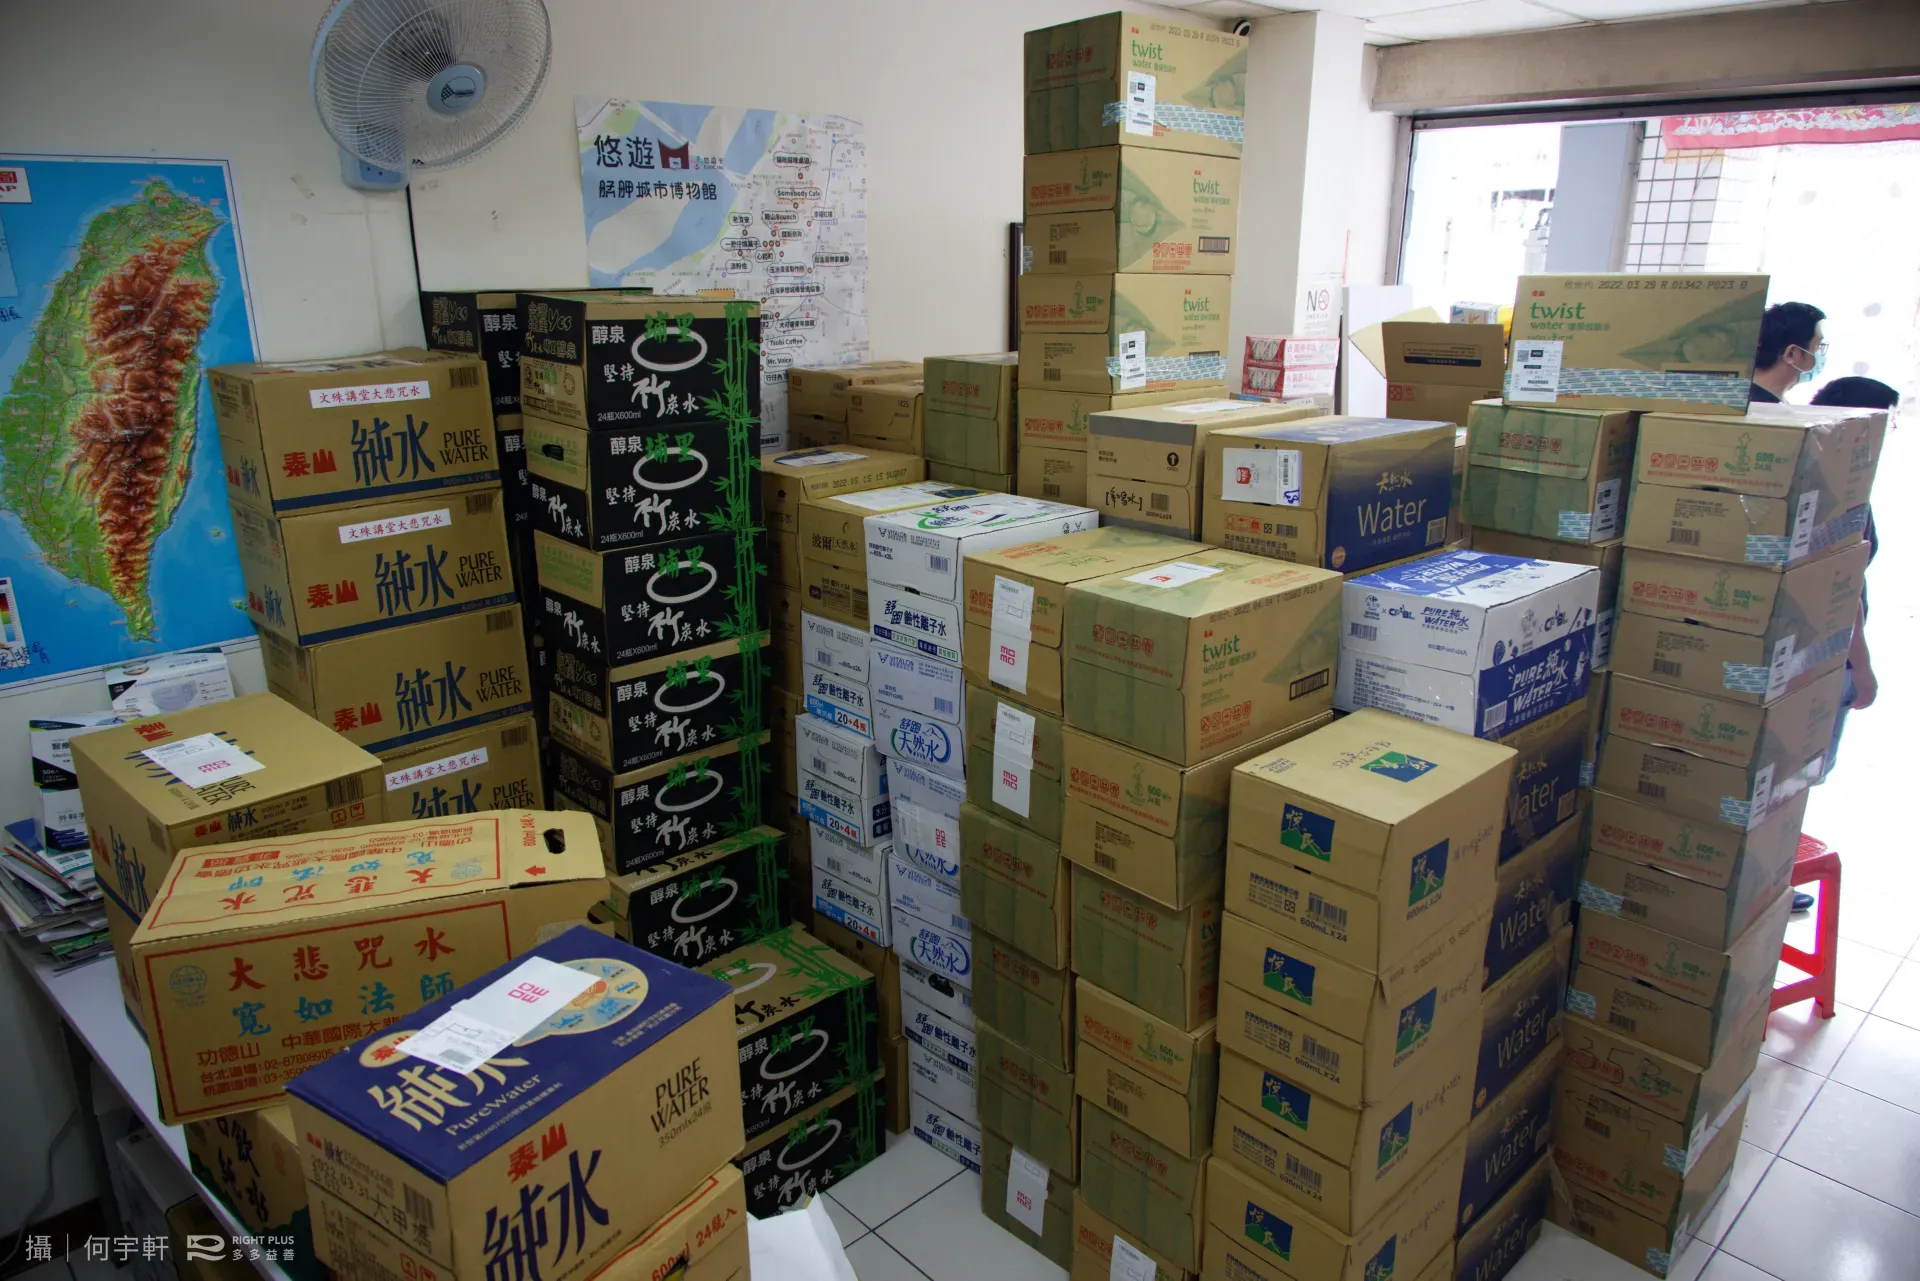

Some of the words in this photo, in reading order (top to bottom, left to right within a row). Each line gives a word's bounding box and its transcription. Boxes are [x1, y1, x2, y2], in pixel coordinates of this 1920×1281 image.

[1131, 39, 1163, 61] twist
[1132, 59, 1152, 70] water
[594, 134, 655, 170] 悠遊
[599, 181, 718, 200] 艋舺城市博物館
[1192, 177, 1220, 196] twist
[1598, 280, 1623, 290] 2022
[1626, 280, 1640, 290] 03
[1643, 280, 1657, 290] 29
[1183, 297, 1209, 312] twist
[1530, 302, 1586, 320] twist
[483, 314, 518, 332] 醇泉
[645, 310, 695, 343] 埔里
[1530, 320, 1565, 331] water
[592, 326, 626, 344] 醇泉
[786, 338, 803, 346] Coffee
[777, 357, 792, 365] Voice
[319, 385, 421, 404] 文殊講堂大悲咒水
[604, 363, 635, 383] 堅持
[631, 374, 699, 418] 竹炭水
[443, 428, 481, 448] PURE
[610, 436, 643, 455] 醇泉
[644, 432, 695, 463] 埔里
[282, 448, 337, 478] 泰山
[351, 414, 436, 486] 純水
[439, 444, 488, 466] WATER
[1376, 468, 1413, 495] 天然水
[606, 485, 636, 505] 堅持
[633, 493, 700, 535] 竹炭水
[1357, 498, 1427, 537] Water
[349, 514, 442, 539] 文殊講堂大悲咒水
[888, 530, 907, 539] VITALON
[459, 551, 496, 572] PURE
[624, 554, 655, 574] 醇泉
[658, 546, 704, 577] 埔里
[307, 580, 359, 609] 泰山
[375, 544, 455, 616] 純水
[456, 567, 502, 589] WATER
[621, 601, 650, 622] 堅持
[648, 607, 711, 646] 竹炭水
[884, 600, 903, 625] 舒跑
[904, 611, 947, 637] 鹼性離子水
[1423, 607, 1449, 617] PURE
[1448, 608, 1469, 627] 純水
[1423, 616, 1457, 629] WATER
[1202, 634, 1240, 663] twist
[889, 656, 915, 667] VITALON
[1203, 660, 1227, 674] water
[1512, 664, 1543, 689] PURE
[1543, 651, 1568, 687] 純水
[479, 665, 515, 687] PURE
[332, 702, 383, 732] 泰山
[395, 660, 473, 732] 純水
[476, 681, 522, 703] WATER
[617, 681, 648, 702] 醇泉
[812, 674, 828, 695] 舒跑
[829, 685, 865, 707] 鹼性離子水
[1512, 680, 1554, 713] WATER
[628, 712, 657, 732] 堅持
[654, 716, 717, 751] 竹炭水
[836, 711, 867, 733] 20+4瓶
[900, 718, 922, 734] 舒跑
[899, 730, 940, 763] 天然水
[389, 754, 480, 786] 文殊講堂大悲咒水
[195, 785, 233, 807] ATER
[225, 776, 256, 797] URE
[492, 779, 529, 800] PURE
[620, 784, 650, 807] 醇泉
[804, 779, 820, 799] 舒跑
[820, 789, 854, 815] 鹼性離子水
[489, 793, 534, 811] WATER
[194, 819, 223, 838] 泰山
[227, 808, 258, 832] 純水
[631, 813, 658, 834] 堅持
[655, 815, 717, 850] 竹炭水
[829, 817, 858, 839] 20+4瓶
[650, 882, 679, 905] 醇泉
[821, 879, 837, 898] 舒跑
[838, 890, 875, 917] 鹼性離子水
[648, 925, 675, 948] 堅持
[847, 919, 877, 941] 20+4瓶
[919, 929, 941, 944] 舒跑
[1301, 917, 1329, 936] 600mL
[1336, 932, 1348, 942] 24
[228, 926, 456, 992] 大悲咒水
[918, 940, 959, 972] 天然水
[232, 972, 455, 1039] 寬如法師
[916, 1012, 934, 1035] 舒跑
[1497, 1005, 1549, 1069] Water
[196, 1042, 261, 1067] 功德山
[739, 1037, 769, 1063] 醇泉
[654, 1056, 702, 1108] PURE
[1330, 1072, 1341, 1084] 24
[445, 1073, 542, 1137] PureWater
[649, 1076, 711, 1136] WATER
[925, 1113, 945, 1136] 舒跑
[507, 1122, 568, 1184] 泰山
[1485, 1116, 1537, 1184] Water
[743, 1150, 772, 1176] 醇泉
[1311, 1190, 1323, 1202] 24
[483, 1149, 610, 1281] 純水
